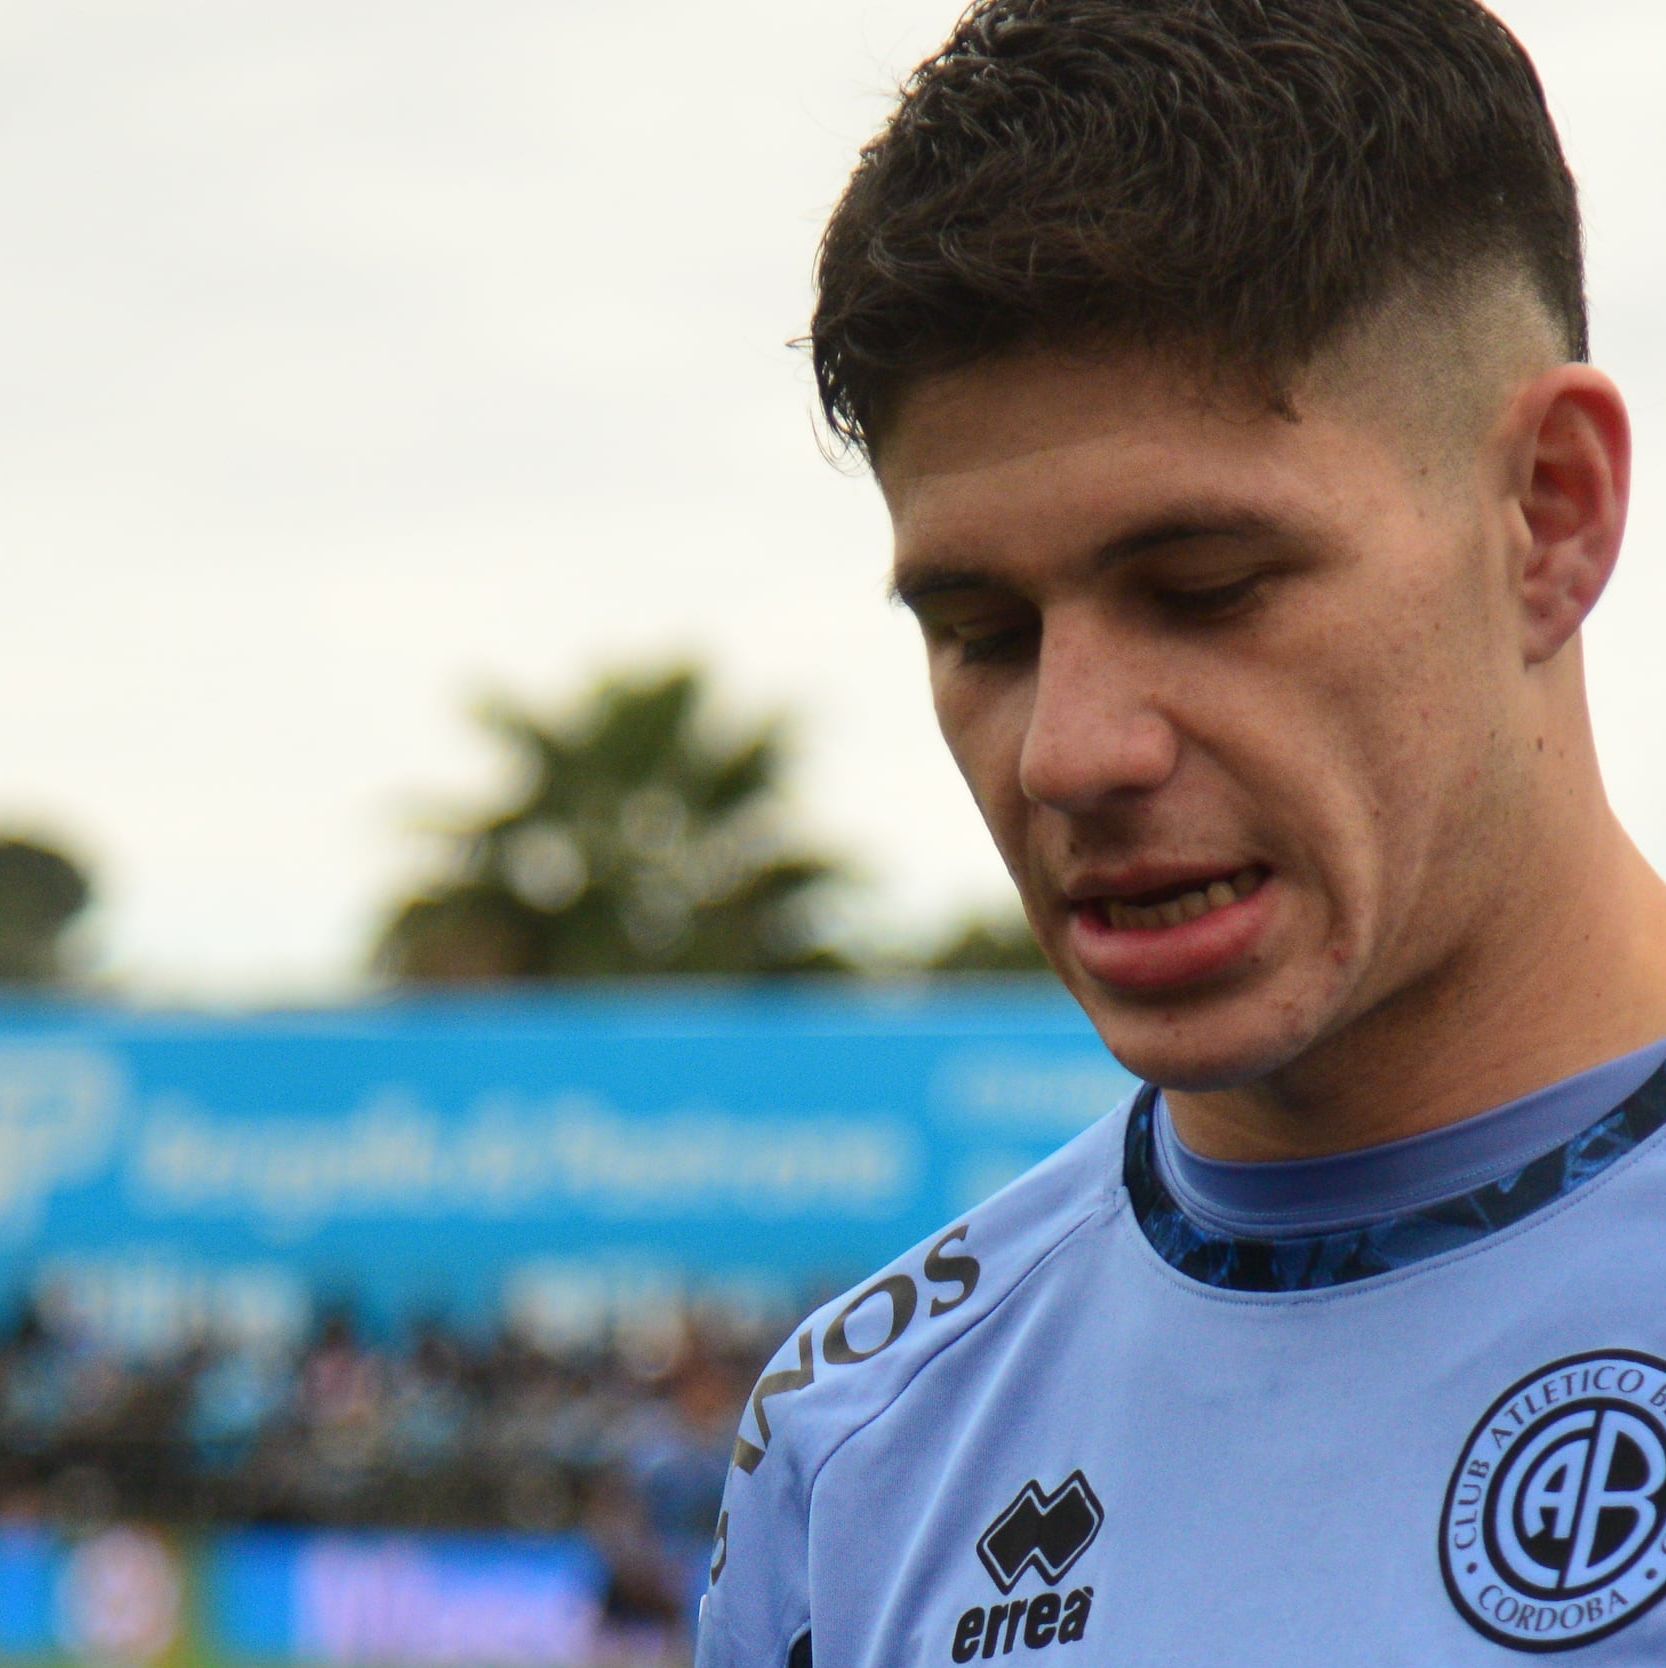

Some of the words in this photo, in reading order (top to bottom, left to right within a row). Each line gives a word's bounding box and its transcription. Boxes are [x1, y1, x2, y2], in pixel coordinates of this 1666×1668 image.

[711, 1224, 981, 1587] NOS
[1454, 1459, 1491, 1551] CLUB
[1491, 1366, 1645, 1450] ATLETICO
[1477, 1584, 1630, 1633] CORDOBA
